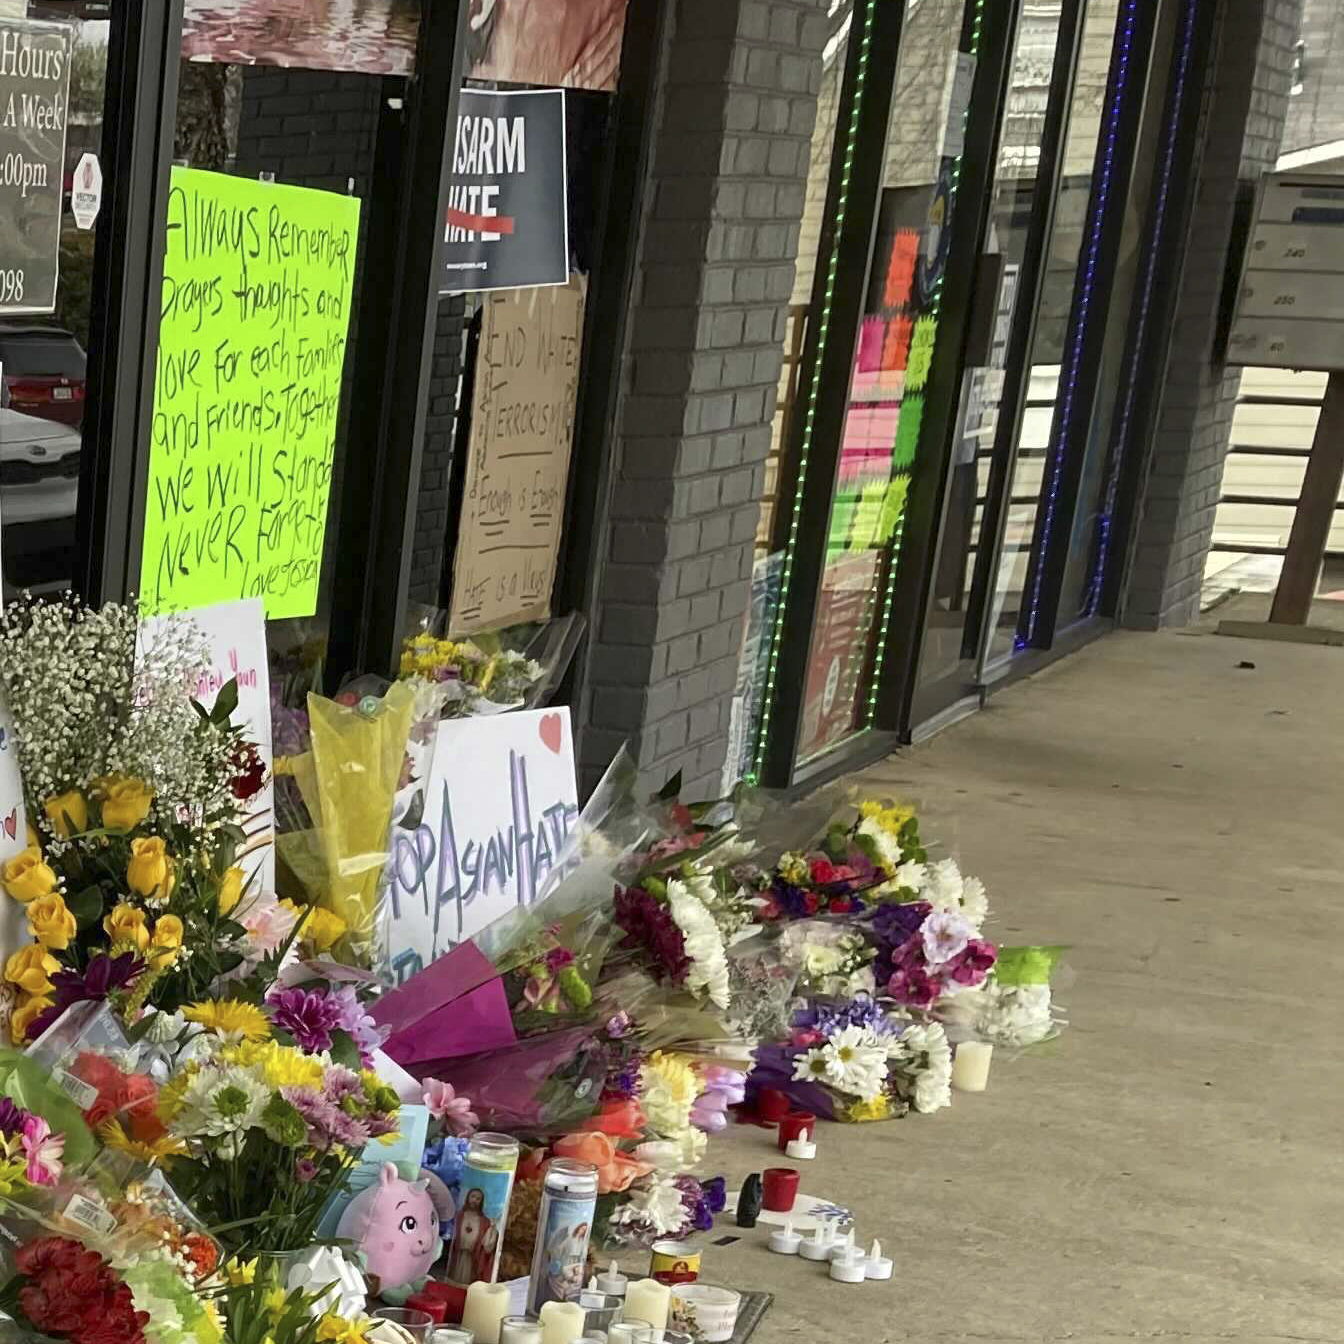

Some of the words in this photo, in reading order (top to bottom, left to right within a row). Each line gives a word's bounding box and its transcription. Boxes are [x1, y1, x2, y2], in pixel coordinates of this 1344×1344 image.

[0, 30, 64, 81] Hours
[3, 91, 17, 127] A
[20, 93, 64, 131] Week
[451, 114, 526, 175] ISARM
[316, 277, 345, 320] and
[152, 391, 200, 458] and
